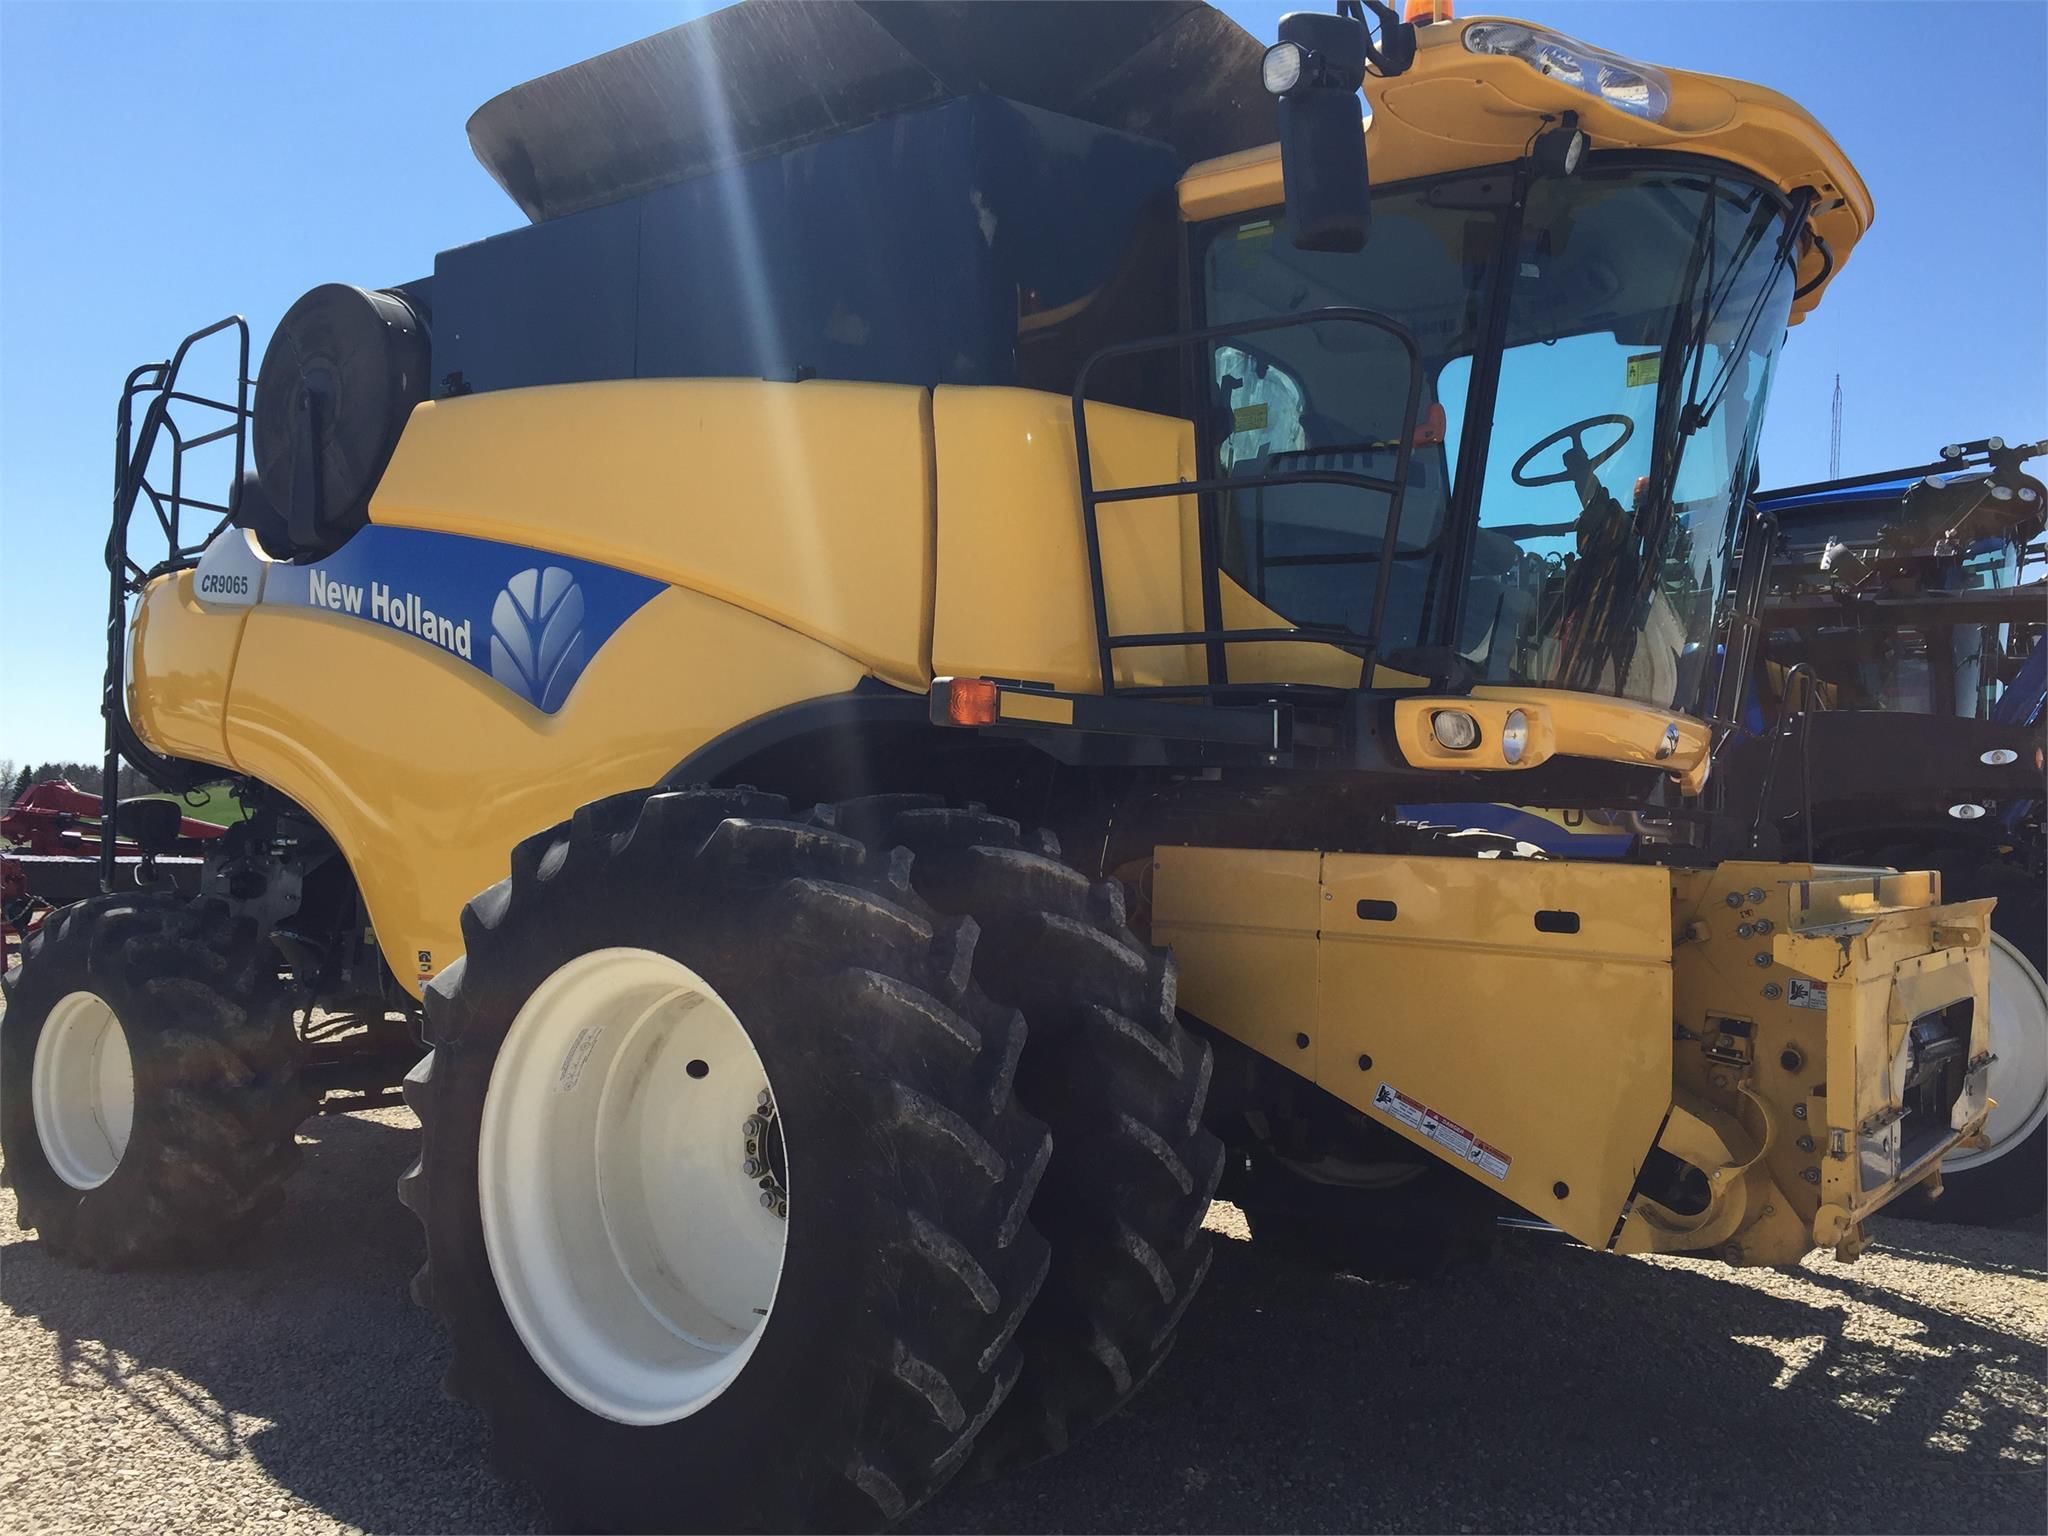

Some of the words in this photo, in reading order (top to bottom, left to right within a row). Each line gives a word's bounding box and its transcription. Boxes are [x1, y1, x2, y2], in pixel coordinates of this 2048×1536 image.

[201, 574, 248, 595] CR9065
[309, 568, 364, 615] New
[371, 581, 472, 660] Holland
